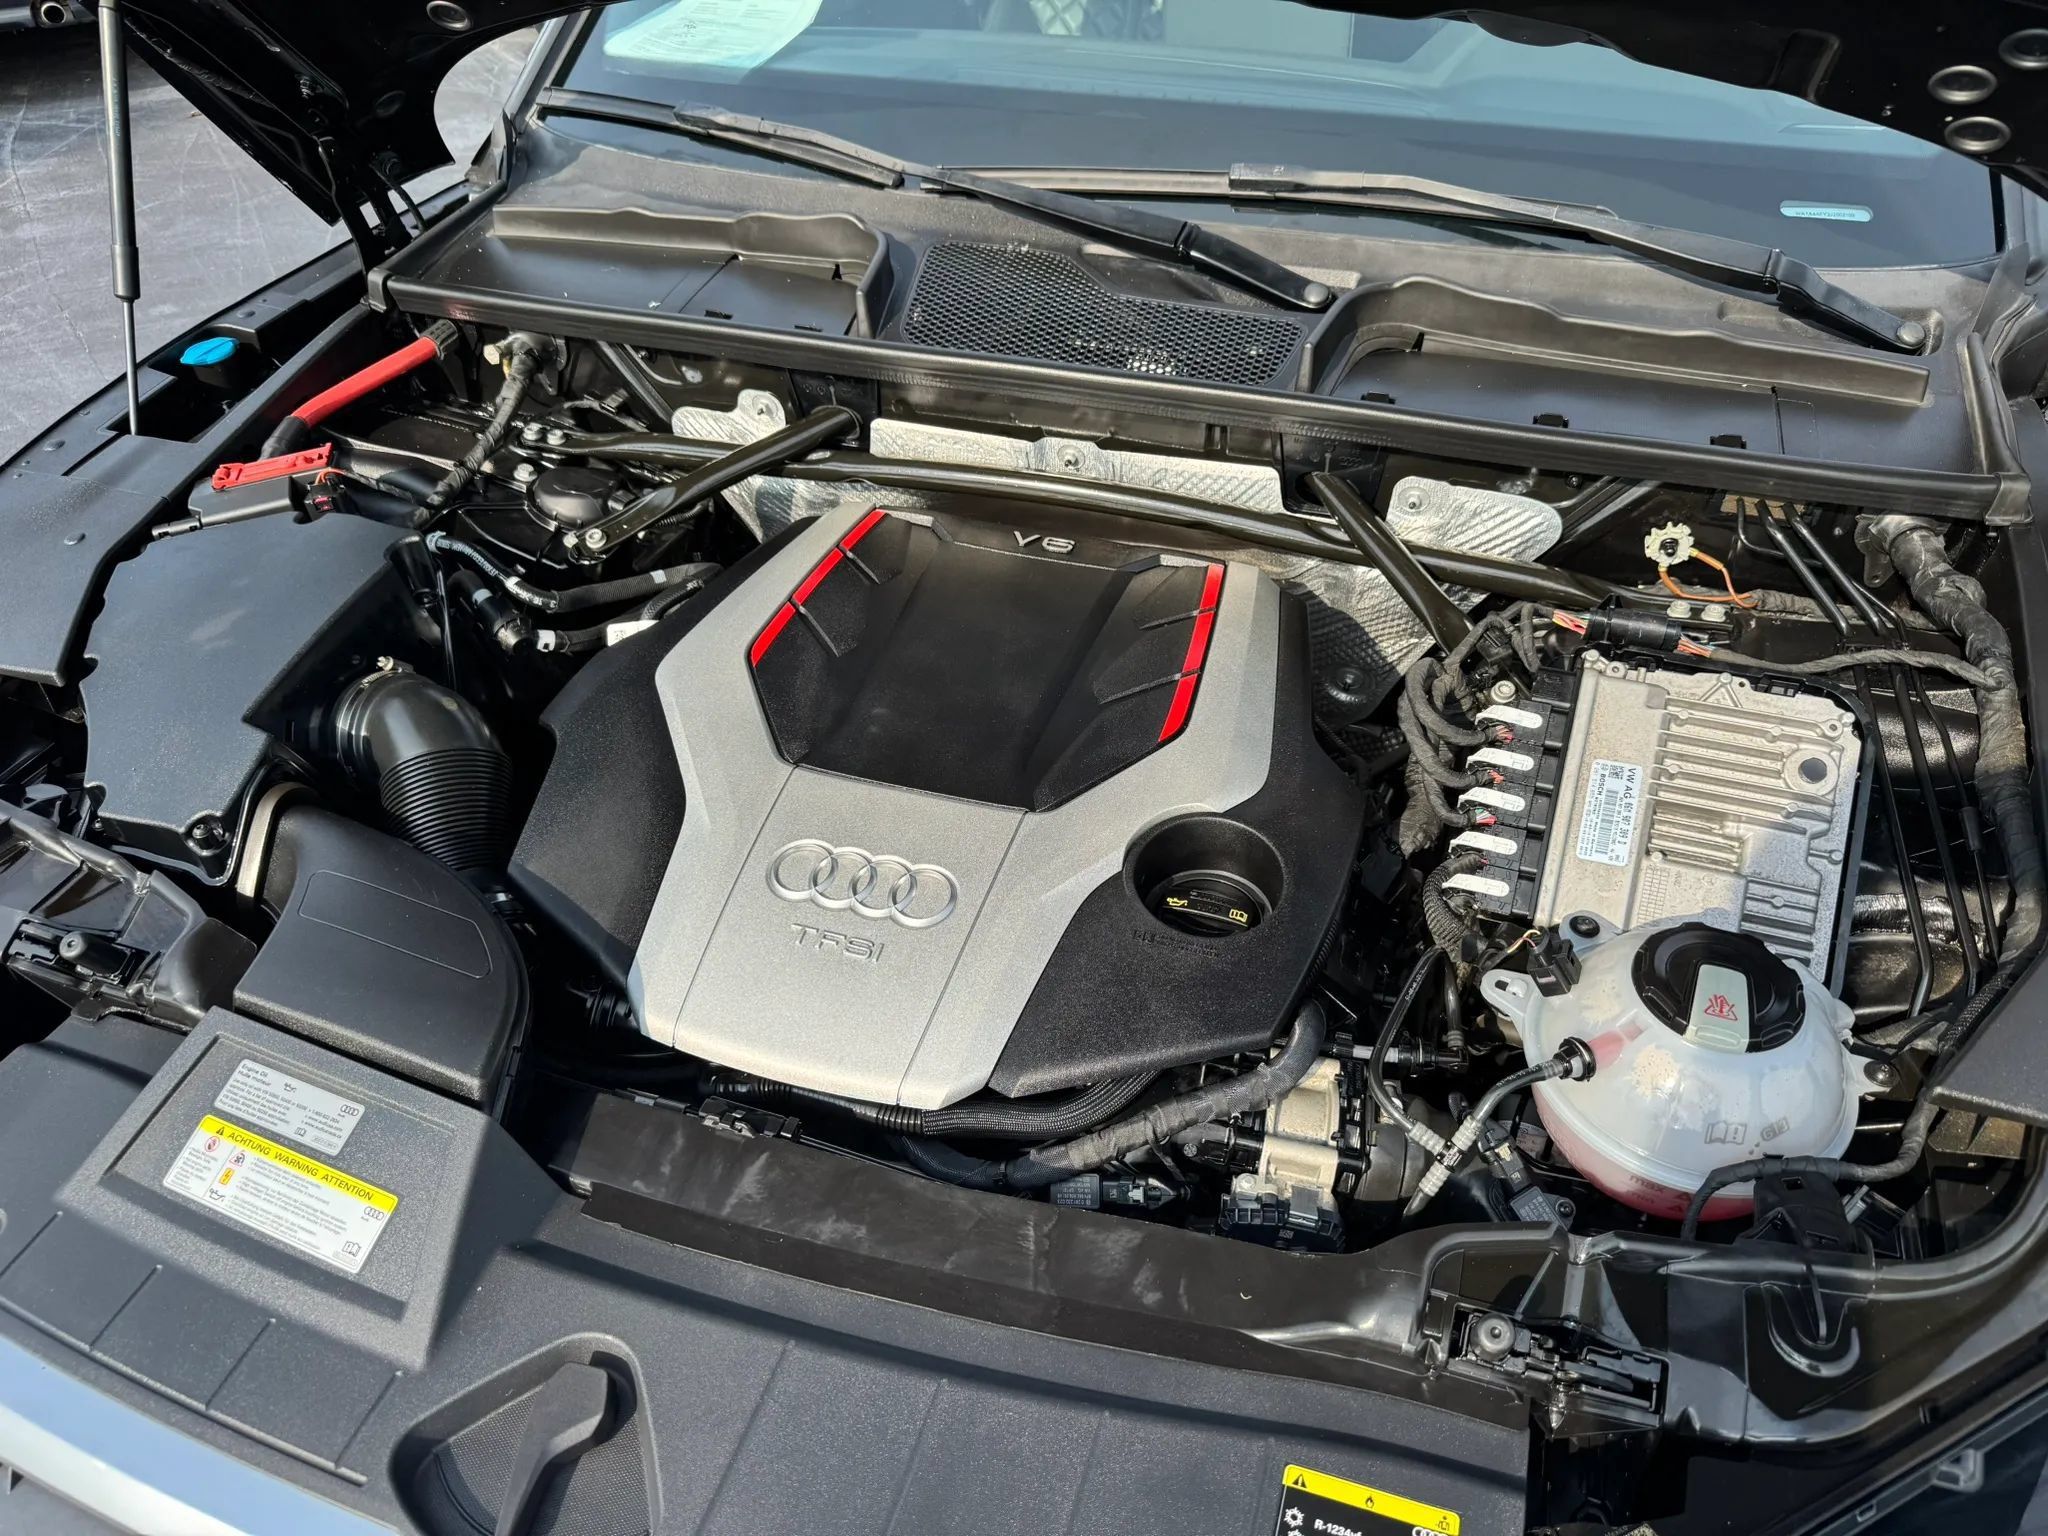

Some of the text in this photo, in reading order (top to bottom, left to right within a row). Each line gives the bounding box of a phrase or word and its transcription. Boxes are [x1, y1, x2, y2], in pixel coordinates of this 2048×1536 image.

[1013, 530, 1076, 554] V6
[1597, 773, 1606, 796] BOSCH
[1627, 767, 1637, 783] VW
[1623, 785, 1633, 800] AG
[790, 922, 885, 965] TFSI
[238, 1070, 272, 1086] Huile moteur
[241, 1063, 260, 1074] Engine
[227, 1131, 271, 1156] ACHTUNG
[274, 1151, 318, 1177] WARNING
[320, 1174, 374, 1201] ATTENTION
[1629, 1175, 1665, 1195] max
